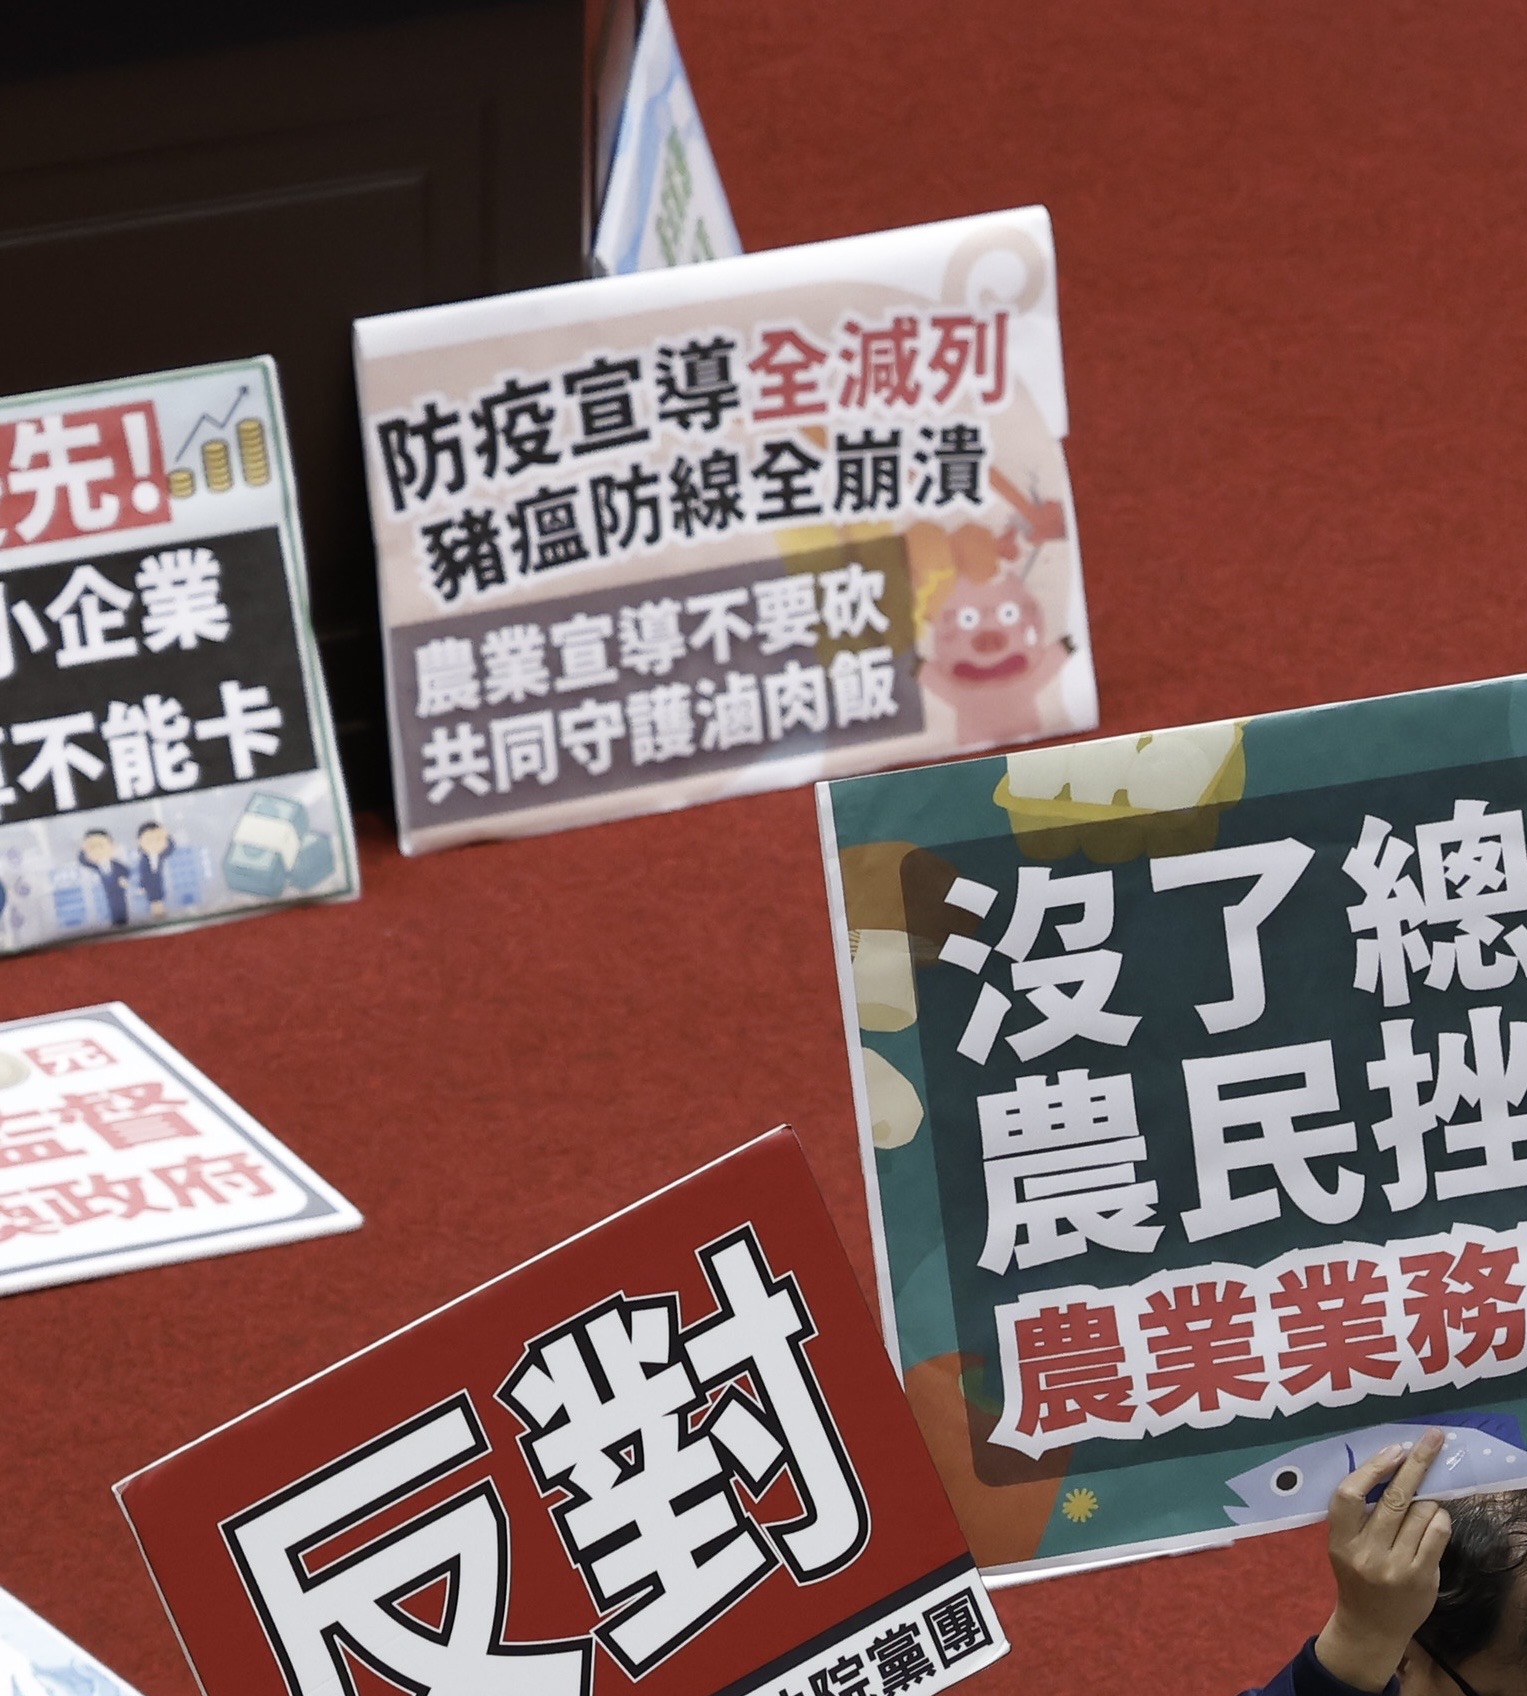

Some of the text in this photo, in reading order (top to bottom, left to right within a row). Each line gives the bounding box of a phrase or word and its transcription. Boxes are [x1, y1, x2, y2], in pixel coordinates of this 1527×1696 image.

[0, 410, 161, 545] 先!
[377, 311, 1010, 512] 防疫宣導全減列
[421, 424, 986, 605] 豬瘟防線全崩潰
[414, 565, 889, 720] 農業宣導不要砍
[0, 679, 283, 812] 不能卡
[421, 649, 899, 805] 共同守護滷肉飯
[0, 1152, 275, 1243] 政府
